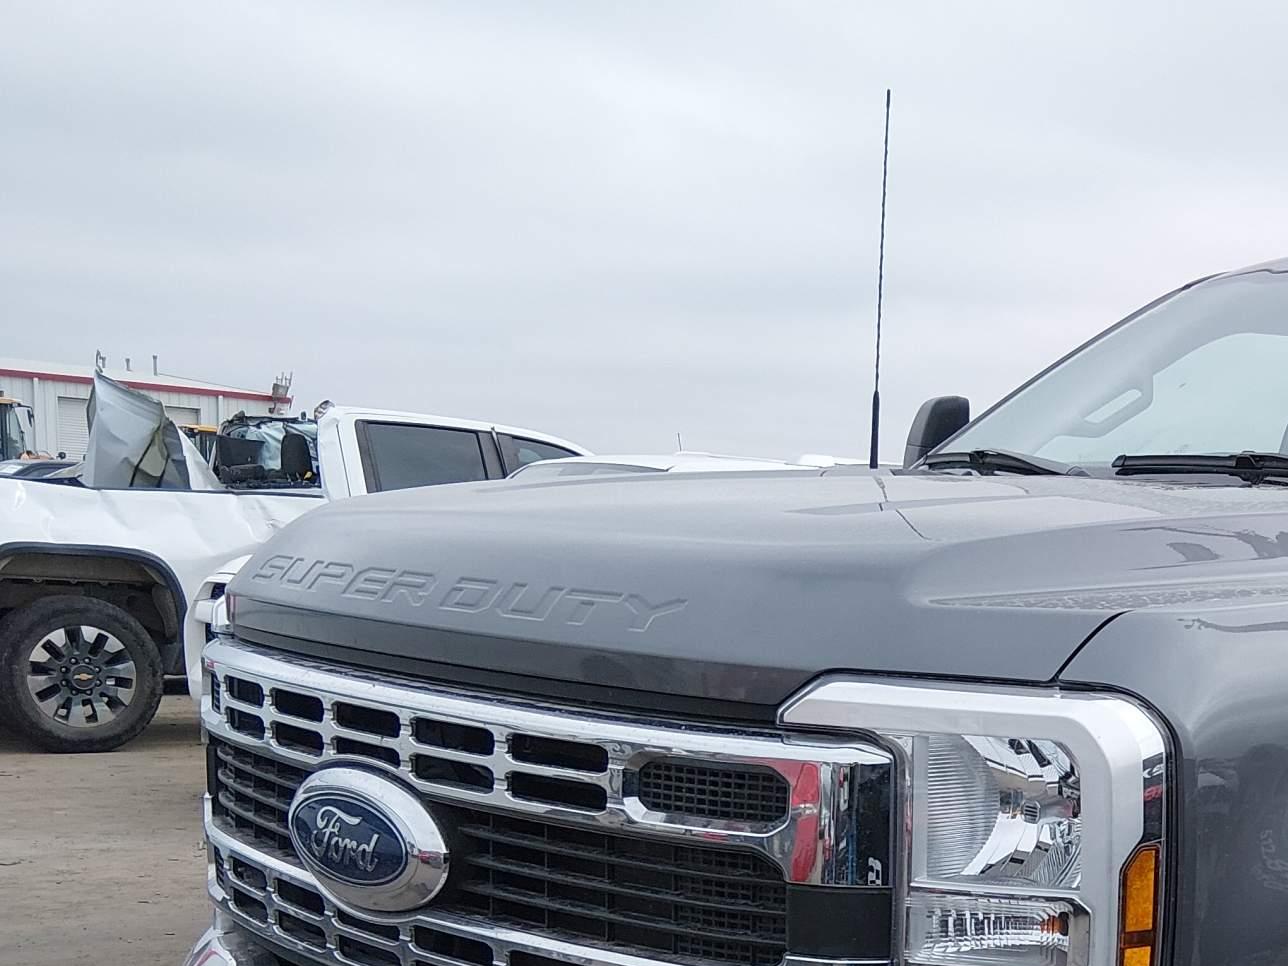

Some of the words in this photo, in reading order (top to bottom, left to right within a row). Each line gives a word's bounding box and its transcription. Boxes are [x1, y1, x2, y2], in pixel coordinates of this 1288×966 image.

[251, 554, 439, 607] SUPER
[439, 576, 689, 633] DUTY
[311, 805, 381, 872] Ford
